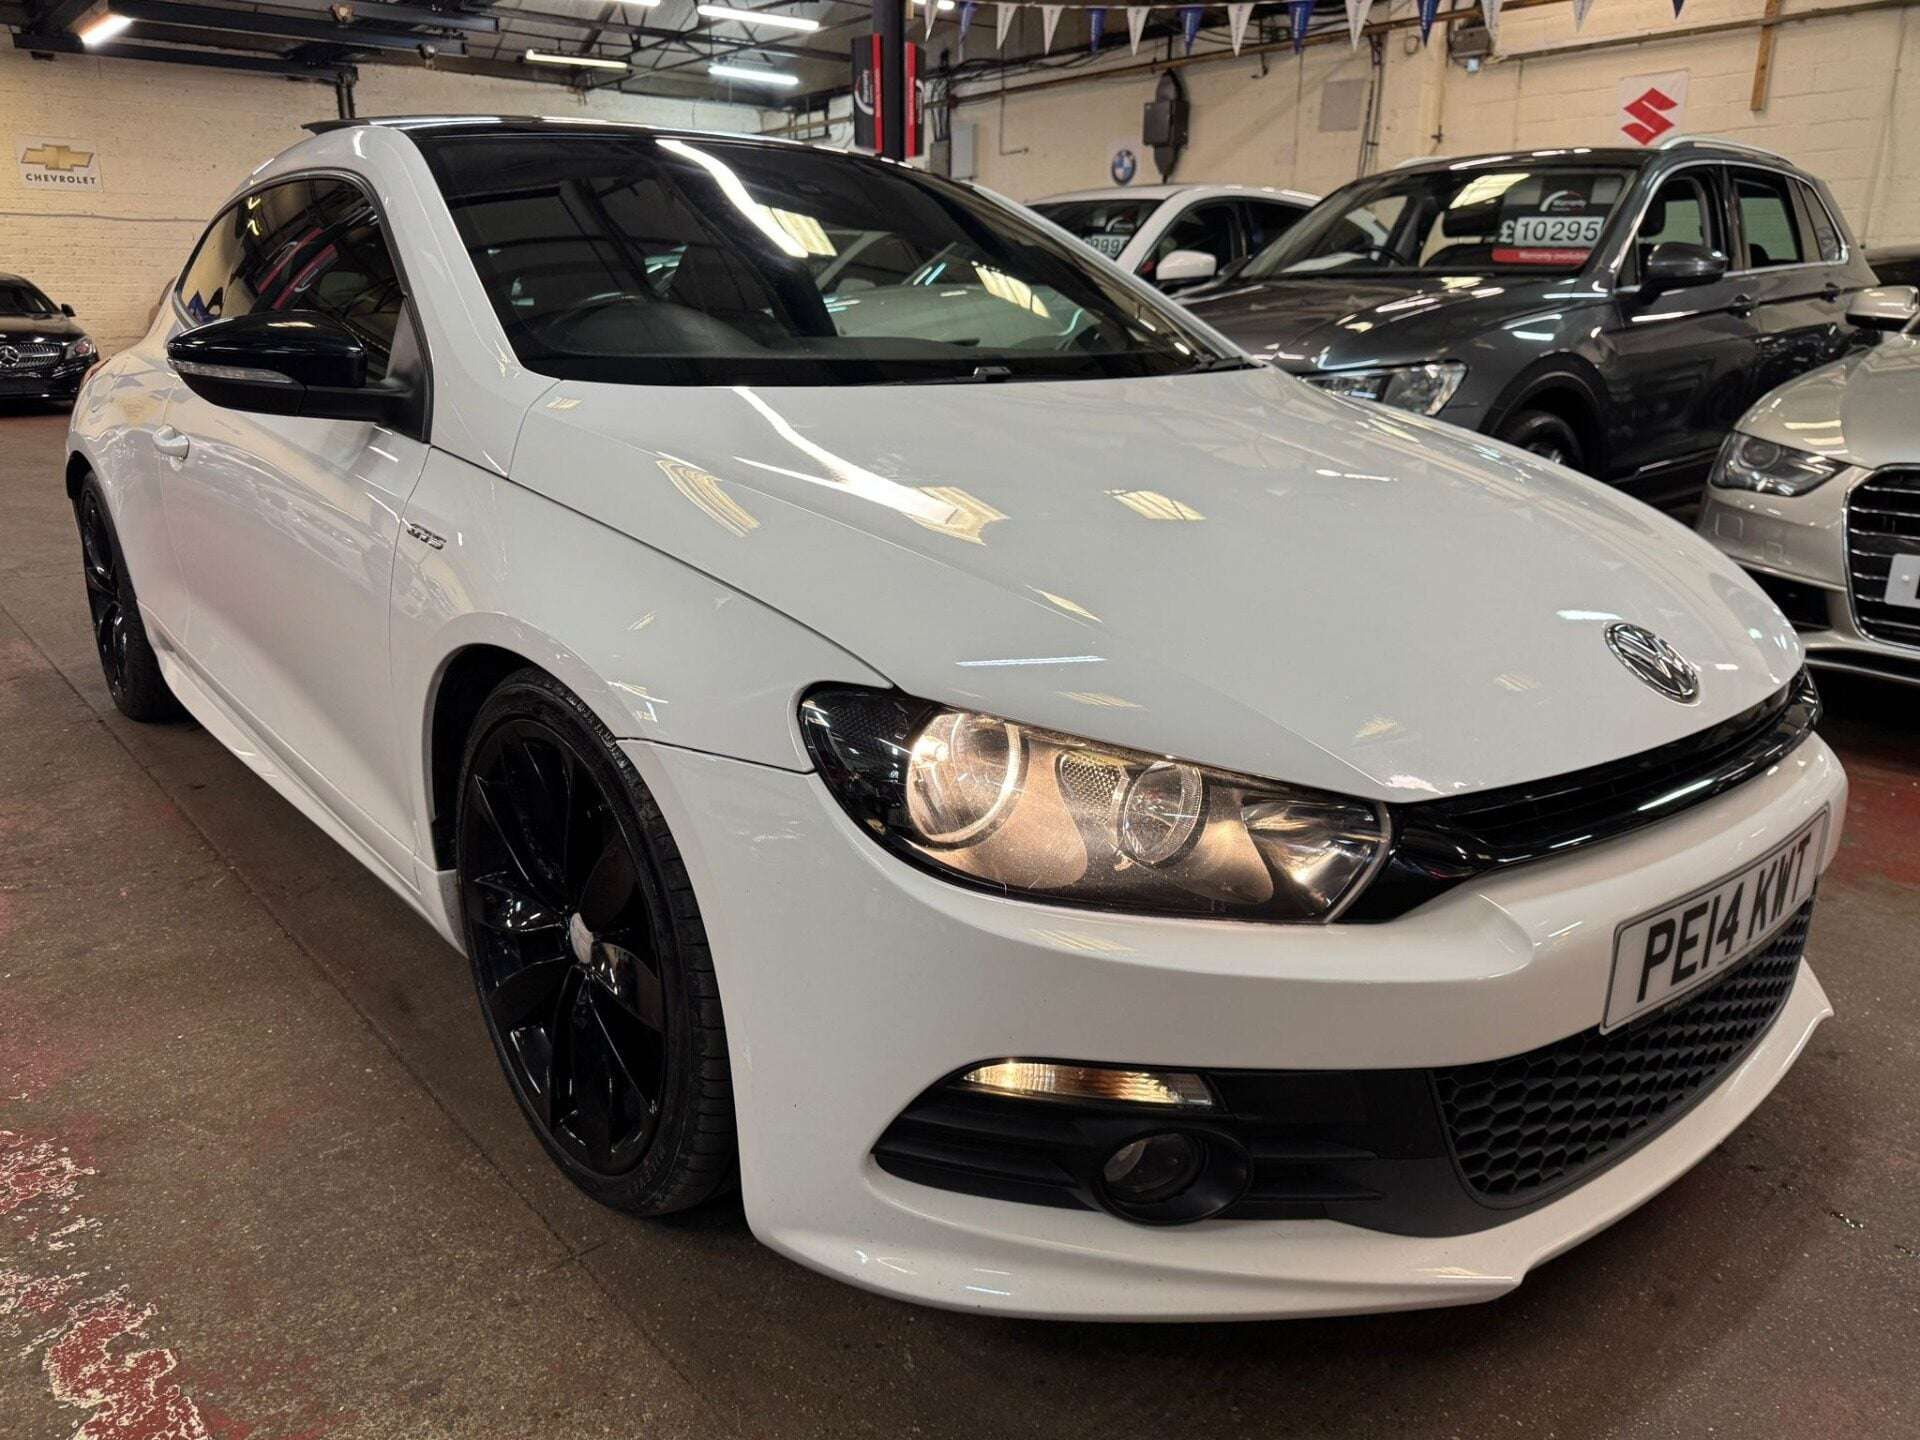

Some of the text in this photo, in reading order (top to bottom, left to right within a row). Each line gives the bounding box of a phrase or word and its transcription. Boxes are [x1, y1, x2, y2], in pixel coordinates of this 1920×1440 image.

[25, 172, 97, 185] CHEVROLET
[1499, 220, 1600, 243] £10295
[1636, 832, 1812, 1004] PE14 KWT
